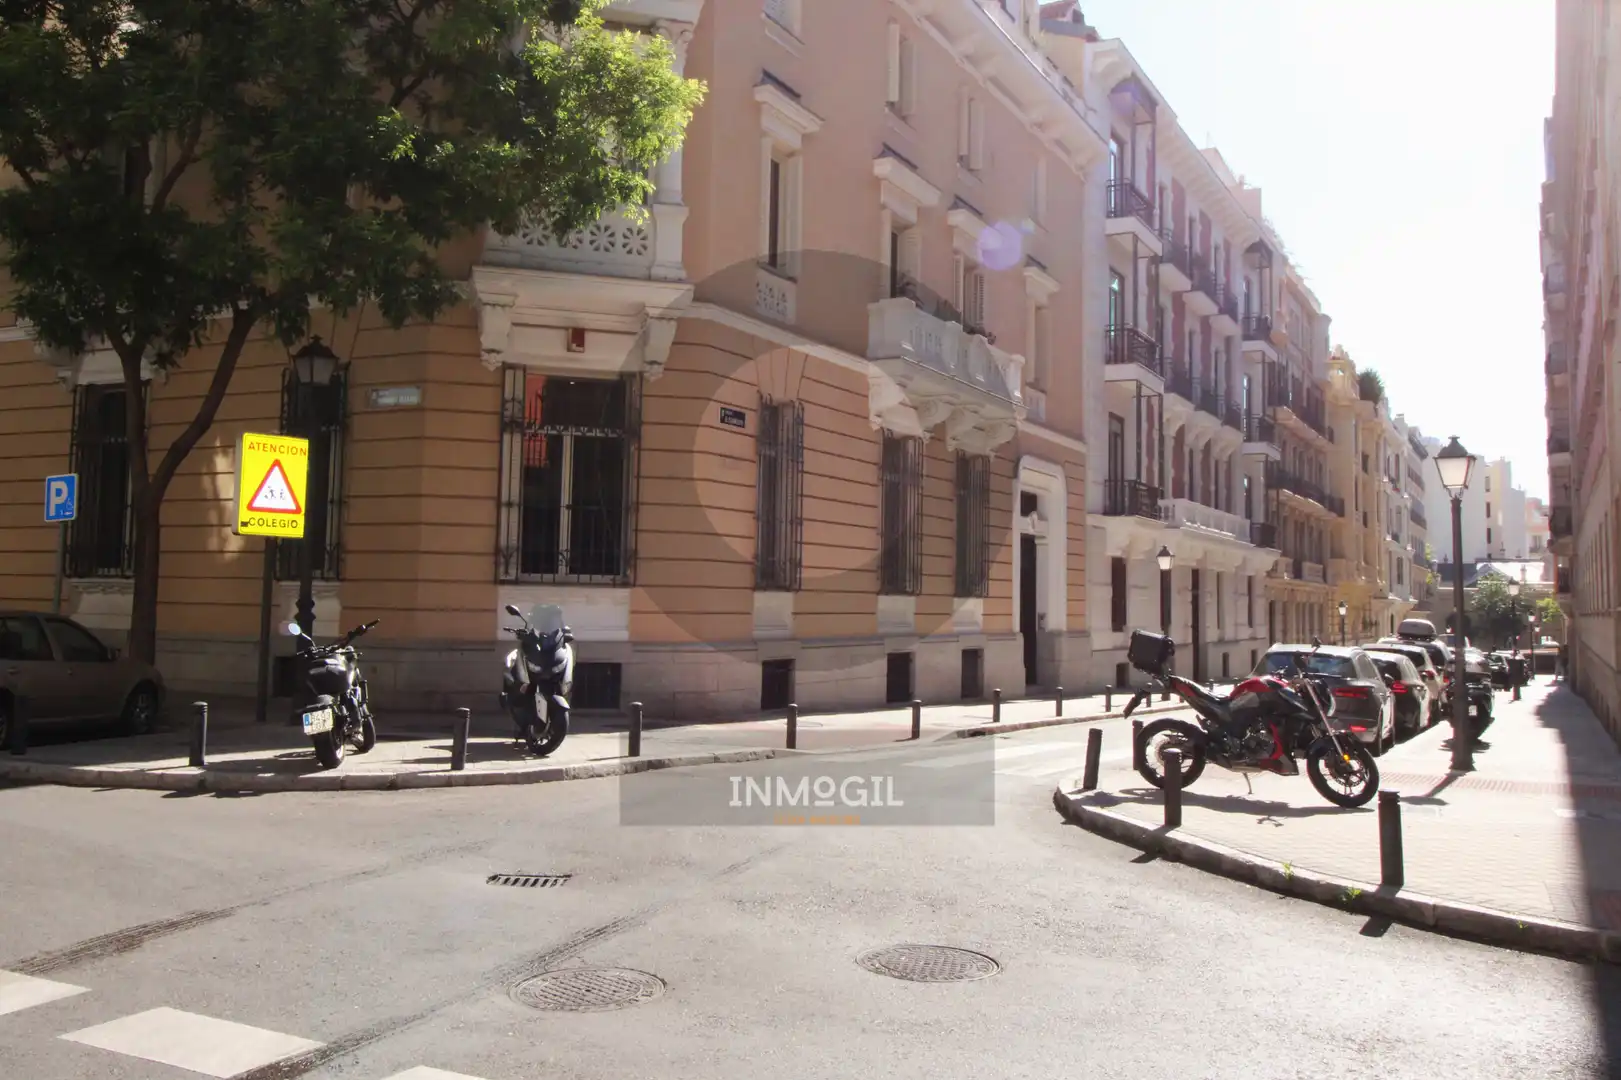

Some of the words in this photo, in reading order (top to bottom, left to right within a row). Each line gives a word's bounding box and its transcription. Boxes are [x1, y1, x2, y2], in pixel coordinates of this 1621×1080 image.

[248, 441, 307, 456] ATENCION
[49, 481, 68, 516] P
[248, 517, 299, 529] COLEGIO
